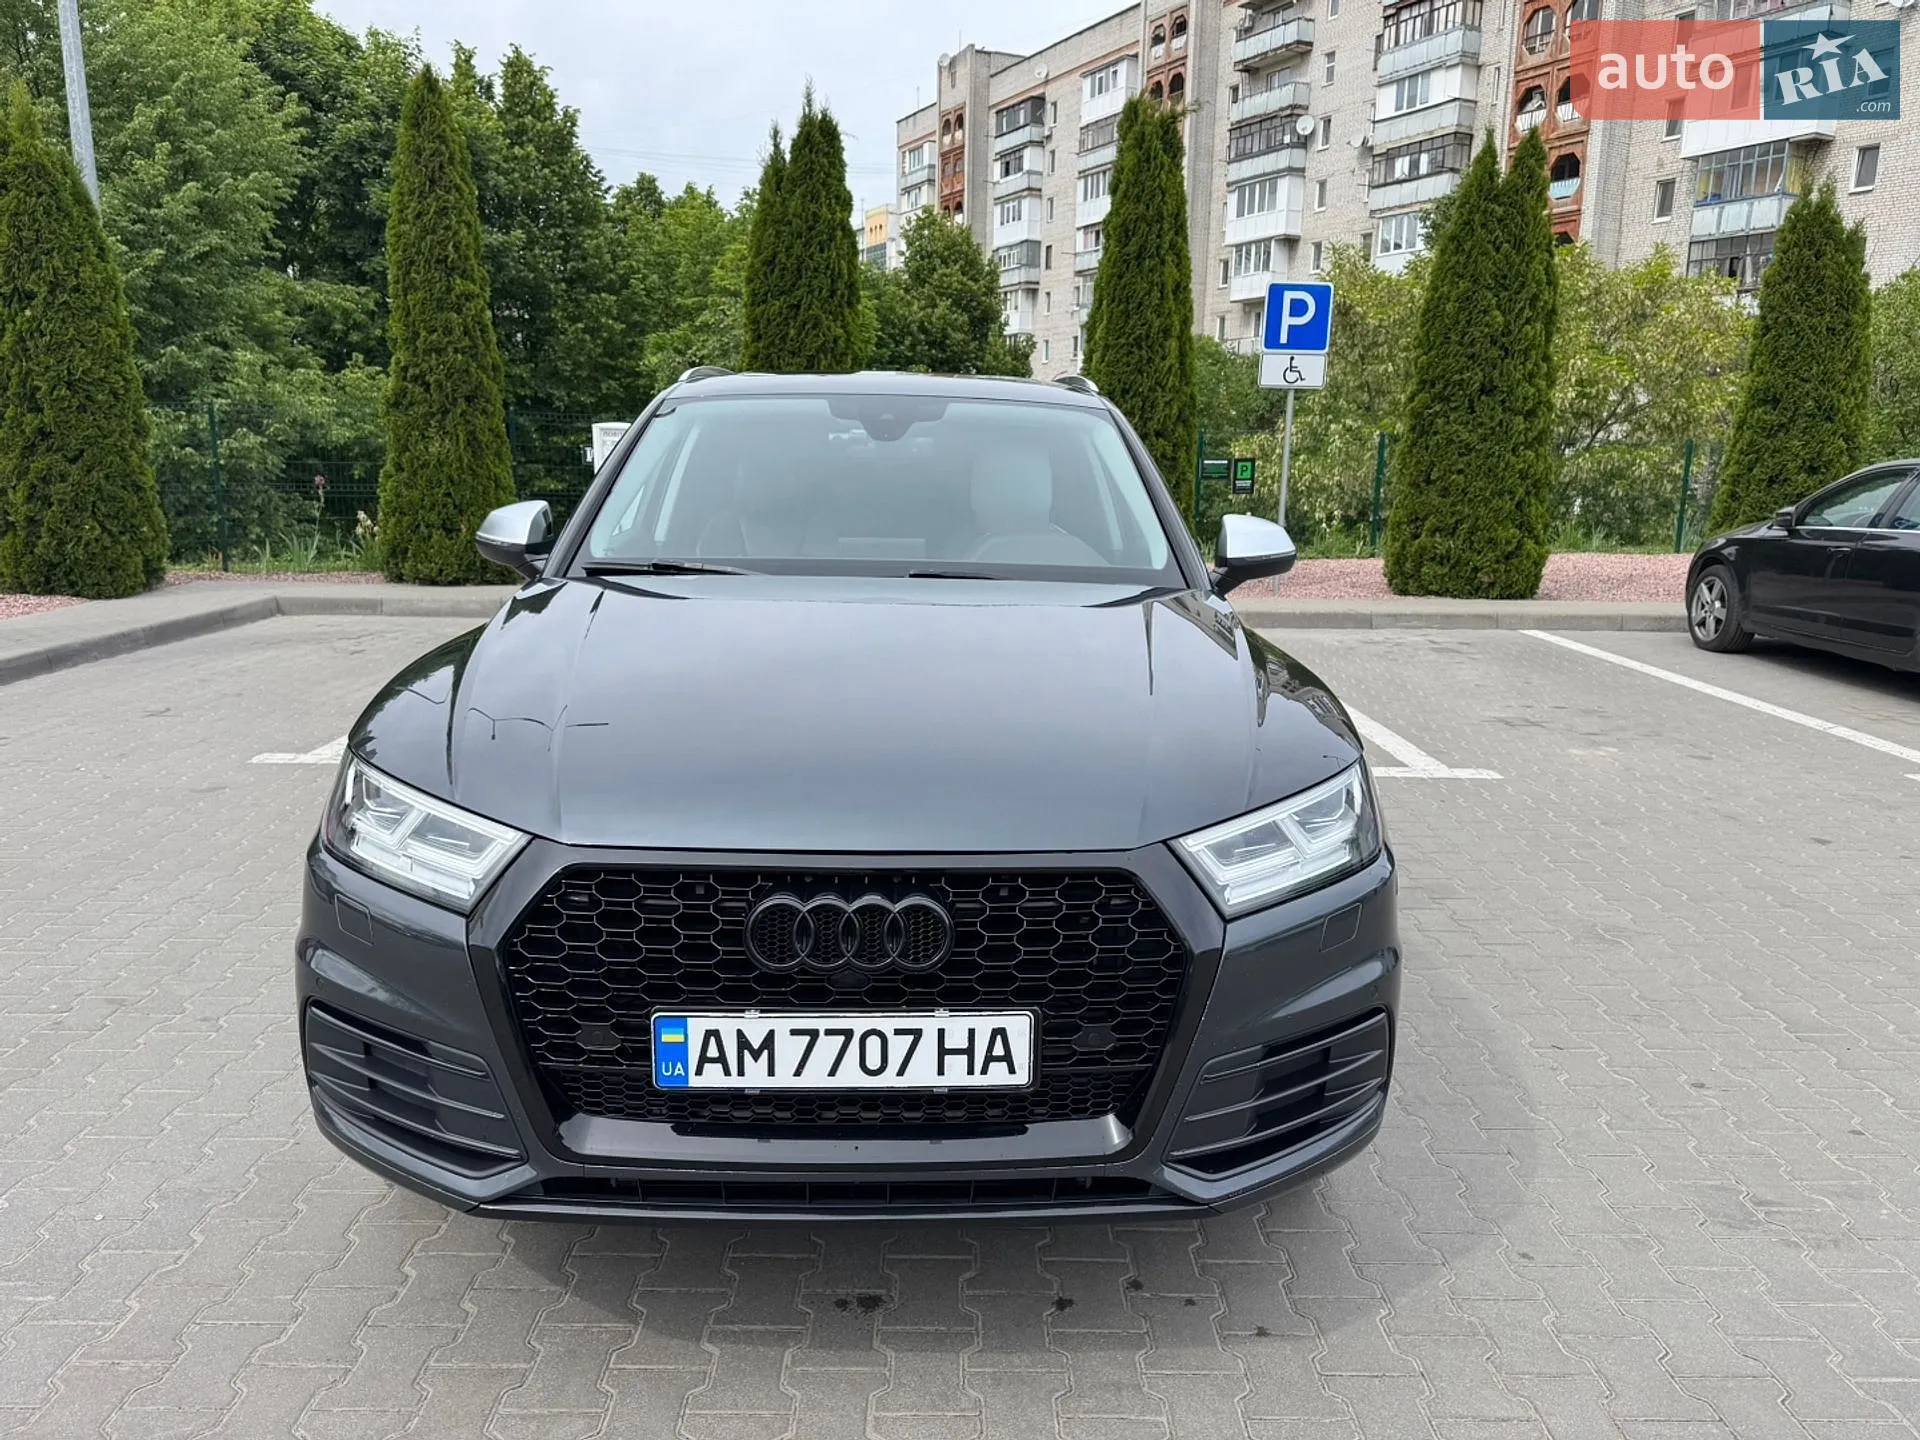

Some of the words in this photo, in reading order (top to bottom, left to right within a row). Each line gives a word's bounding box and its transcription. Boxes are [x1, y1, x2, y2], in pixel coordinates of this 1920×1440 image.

[1280, 290, 1316, 344] P
[1240, 465, 1249, 476] P
[694, 1028, 776, 1077] AM
[789, 1028, 923, 1077] 7707
[937, 1027, 1017, 1076] HA
[662, 1061, 685, 1076] UA
